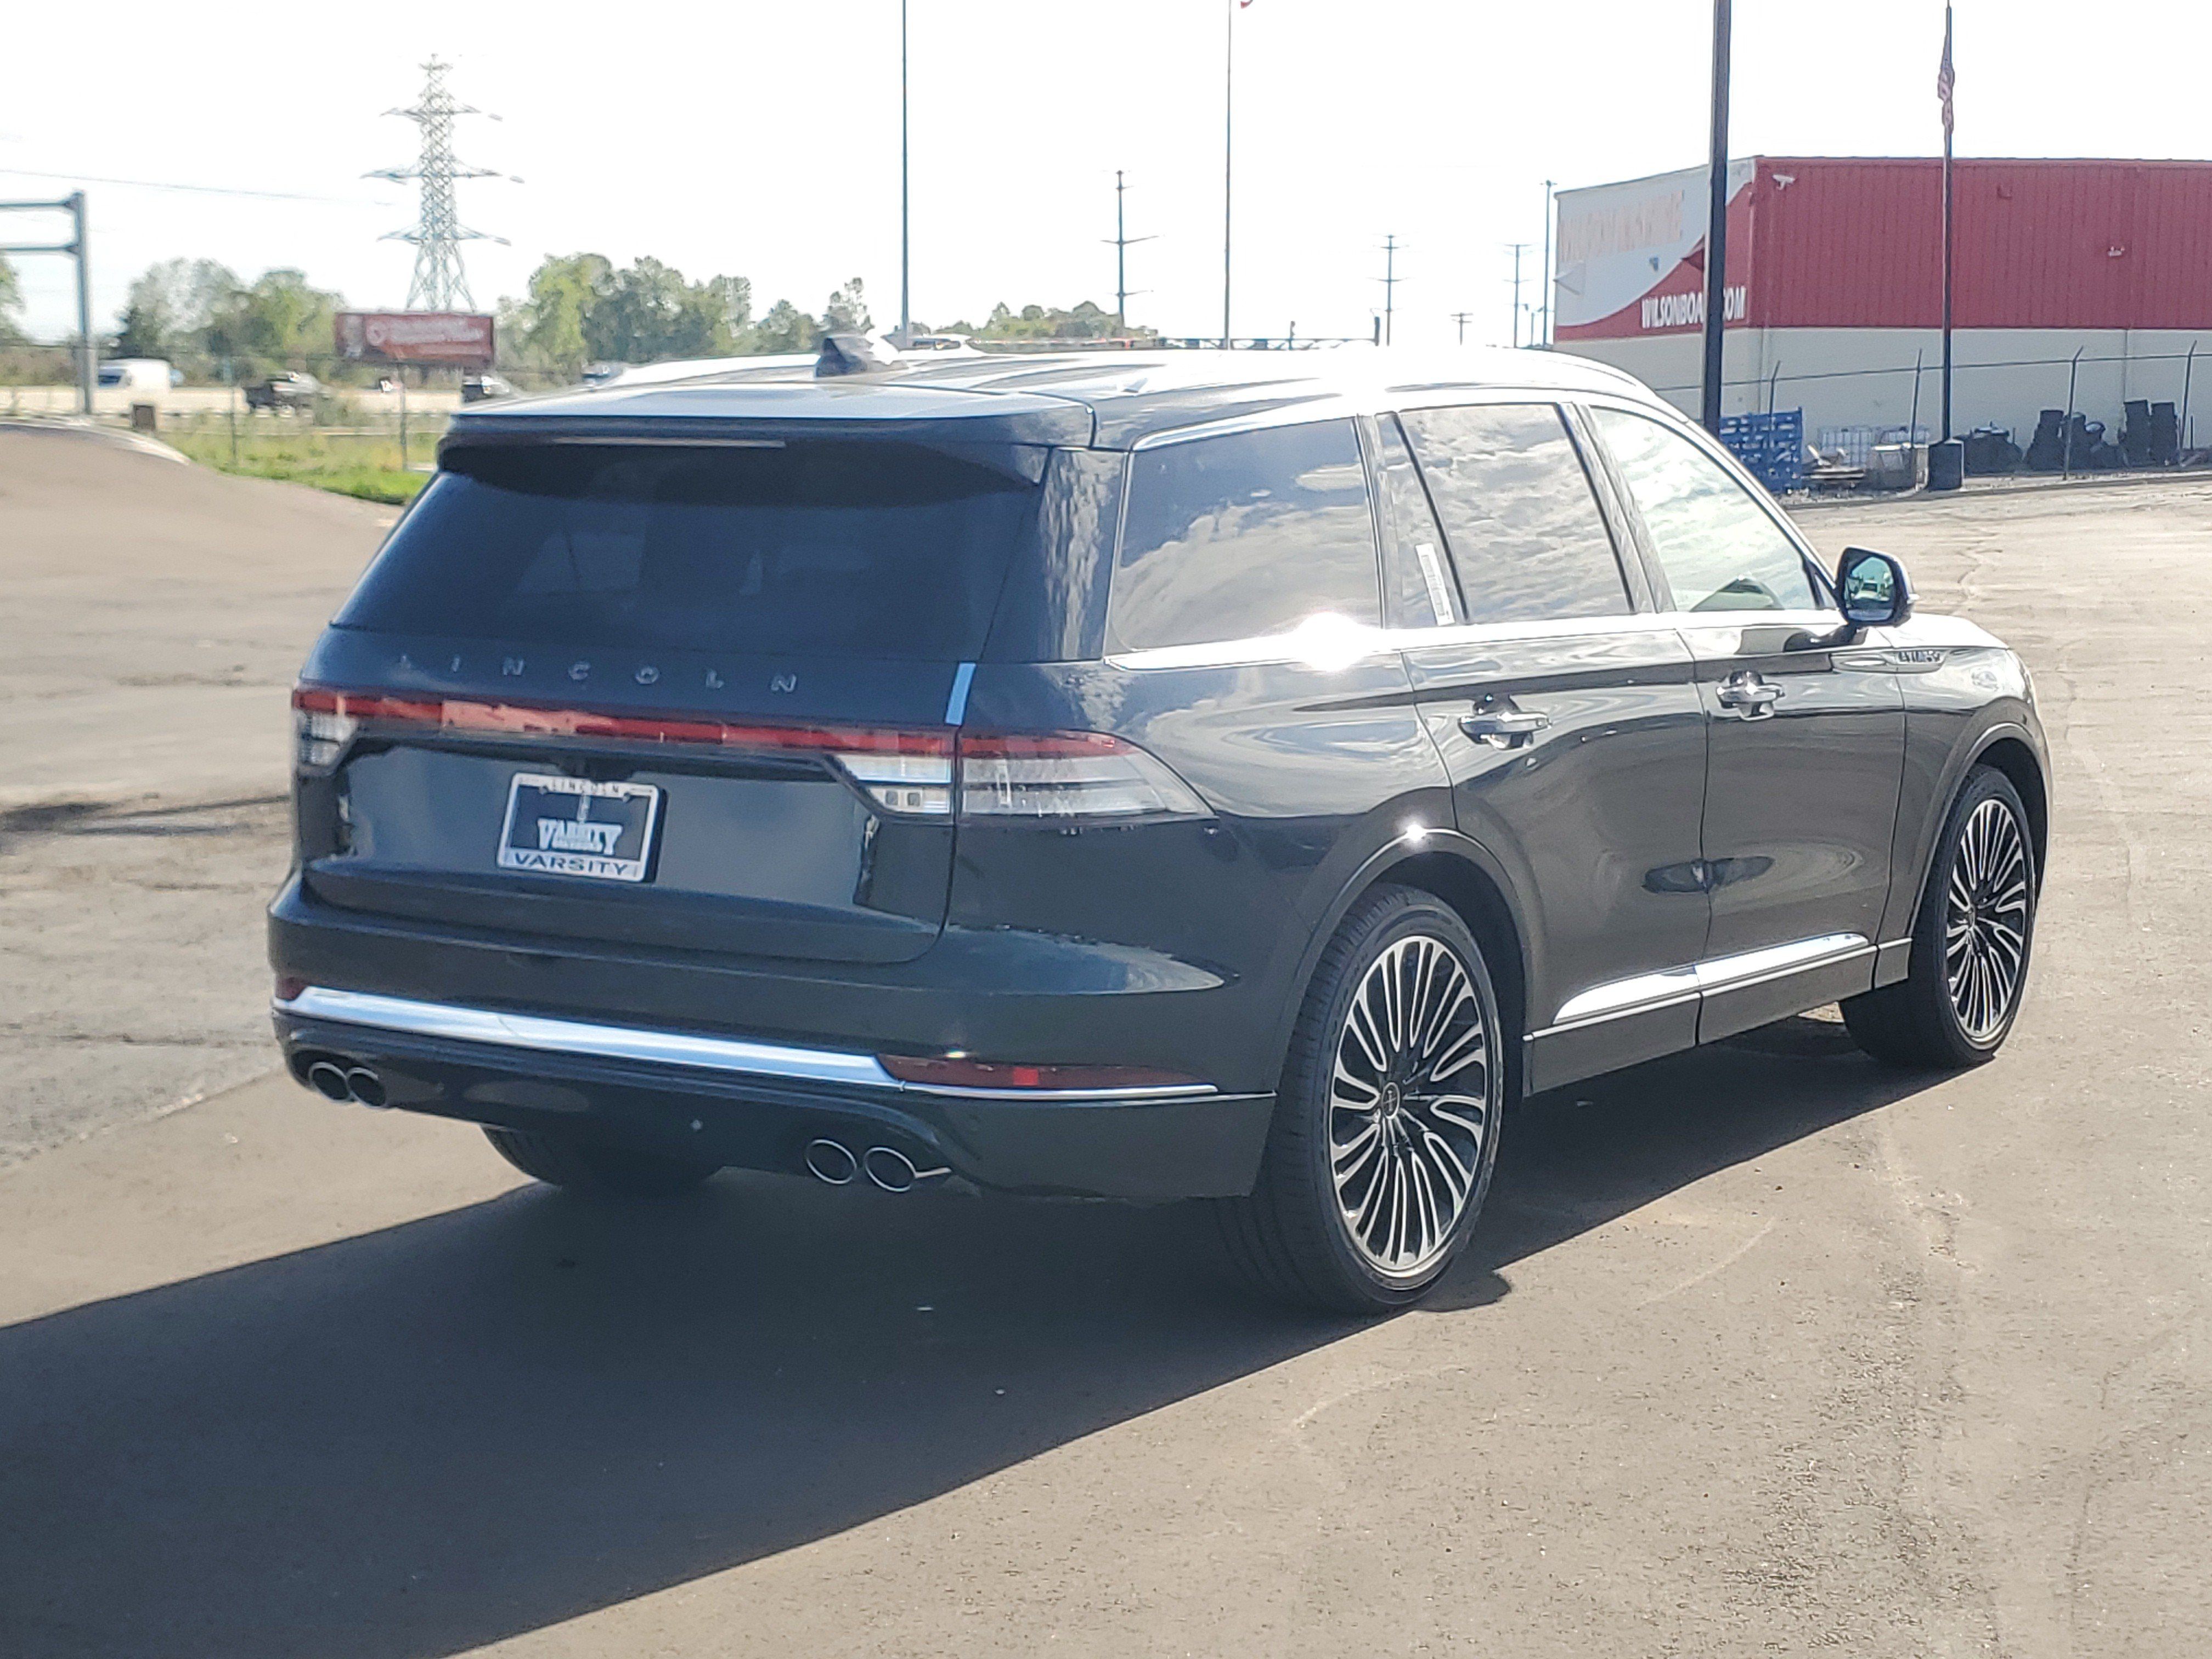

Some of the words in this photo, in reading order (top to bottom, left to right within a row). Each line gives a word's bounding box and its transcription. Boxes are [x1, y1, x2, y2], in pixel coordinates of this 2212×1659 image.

[1641, 286, 1747, 329] WILSONBOAOM
[399, 653, 797, 693] LINCOLN
[514, 852, 628, 876] VARSITY
